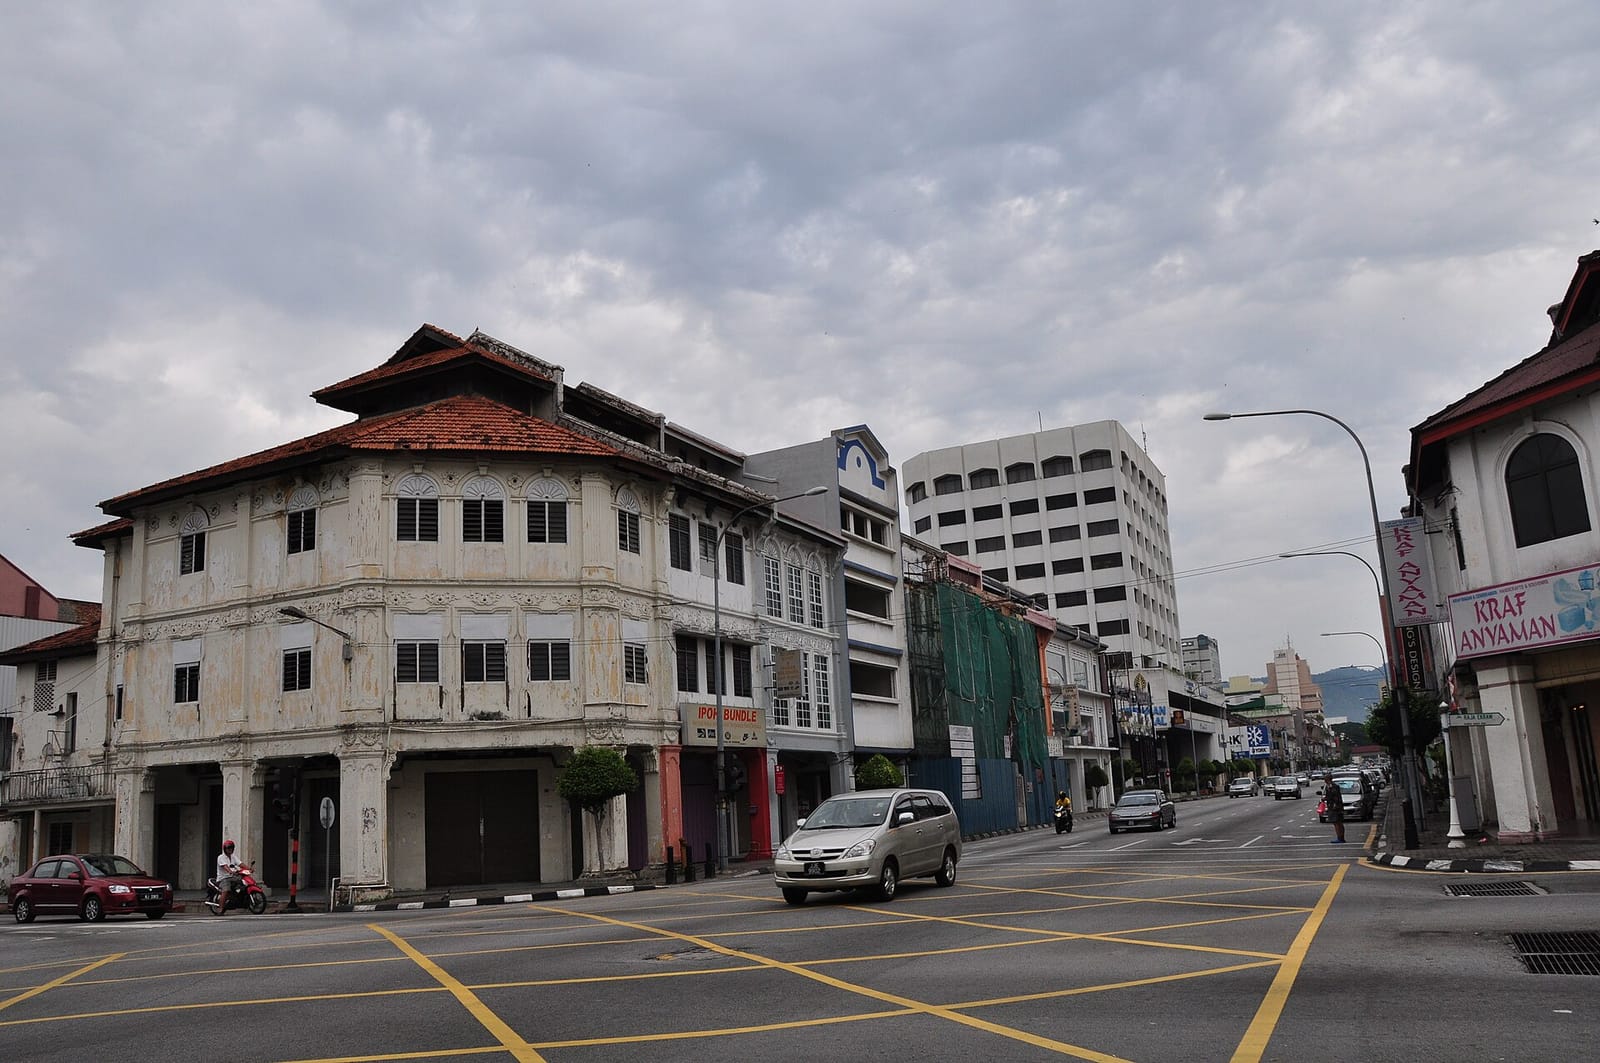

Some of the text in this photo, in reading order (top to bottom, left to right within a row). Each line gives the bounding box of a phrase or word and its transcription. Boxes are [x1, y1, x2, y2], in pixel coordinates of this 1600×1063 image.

[1474, 591, 1526, 625] KRAF
[1460, 614, 1556, 652] ANYAMAN
[1408, 651, 1422, 689] DESIGN
[723, 708, 757, 723] BUNDLE
